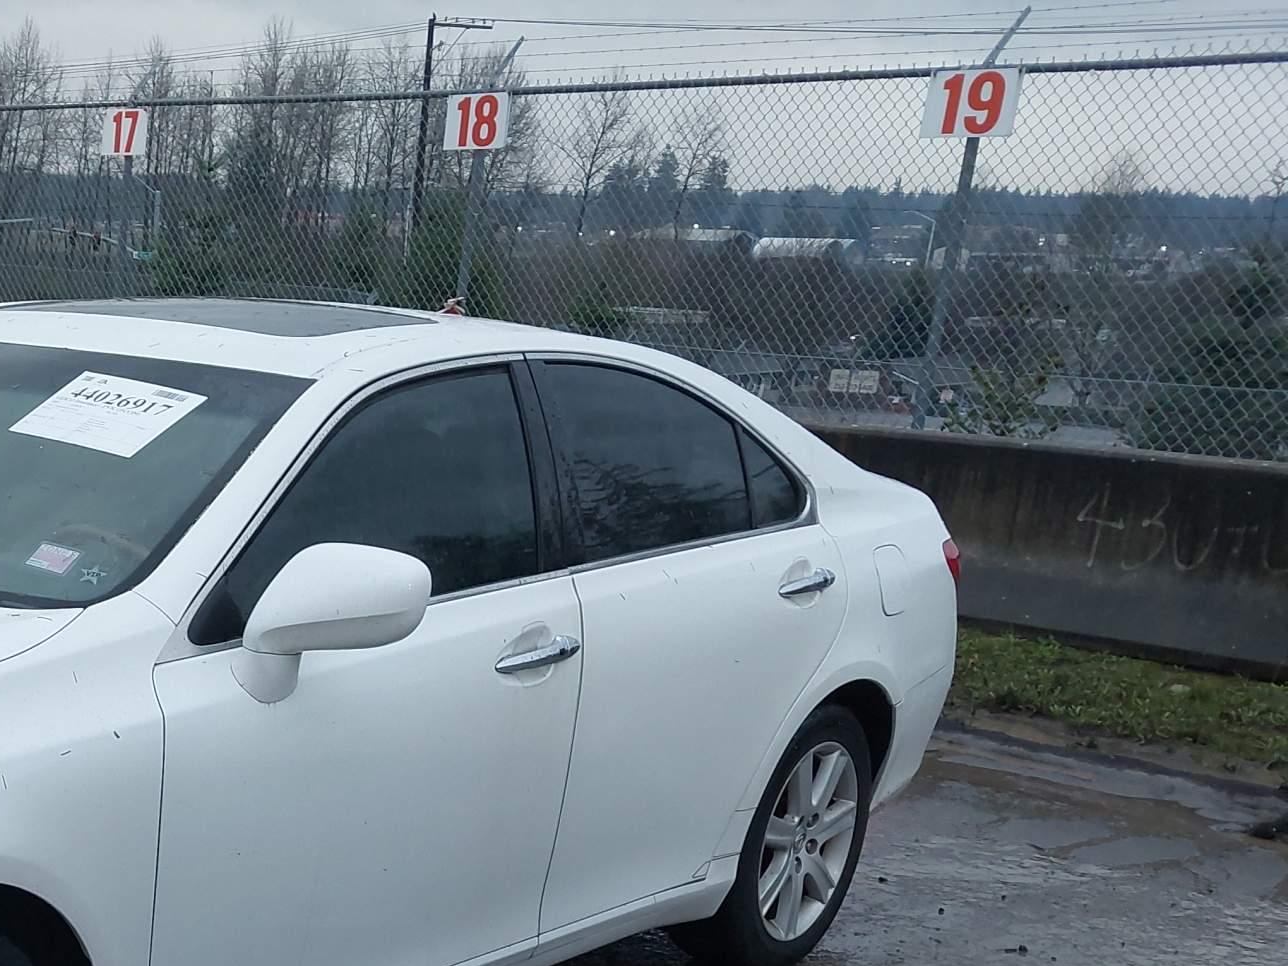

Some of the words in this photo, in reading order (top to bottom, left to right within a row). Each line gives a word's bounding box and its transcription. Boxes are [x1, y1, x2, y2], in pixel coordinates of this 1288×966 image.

[457, 95, 499, 148] 18
[941, 71, 1005, 134] 19
[112, 111, 140, 153] 17
[71, 386, 174, 416] 44026917
